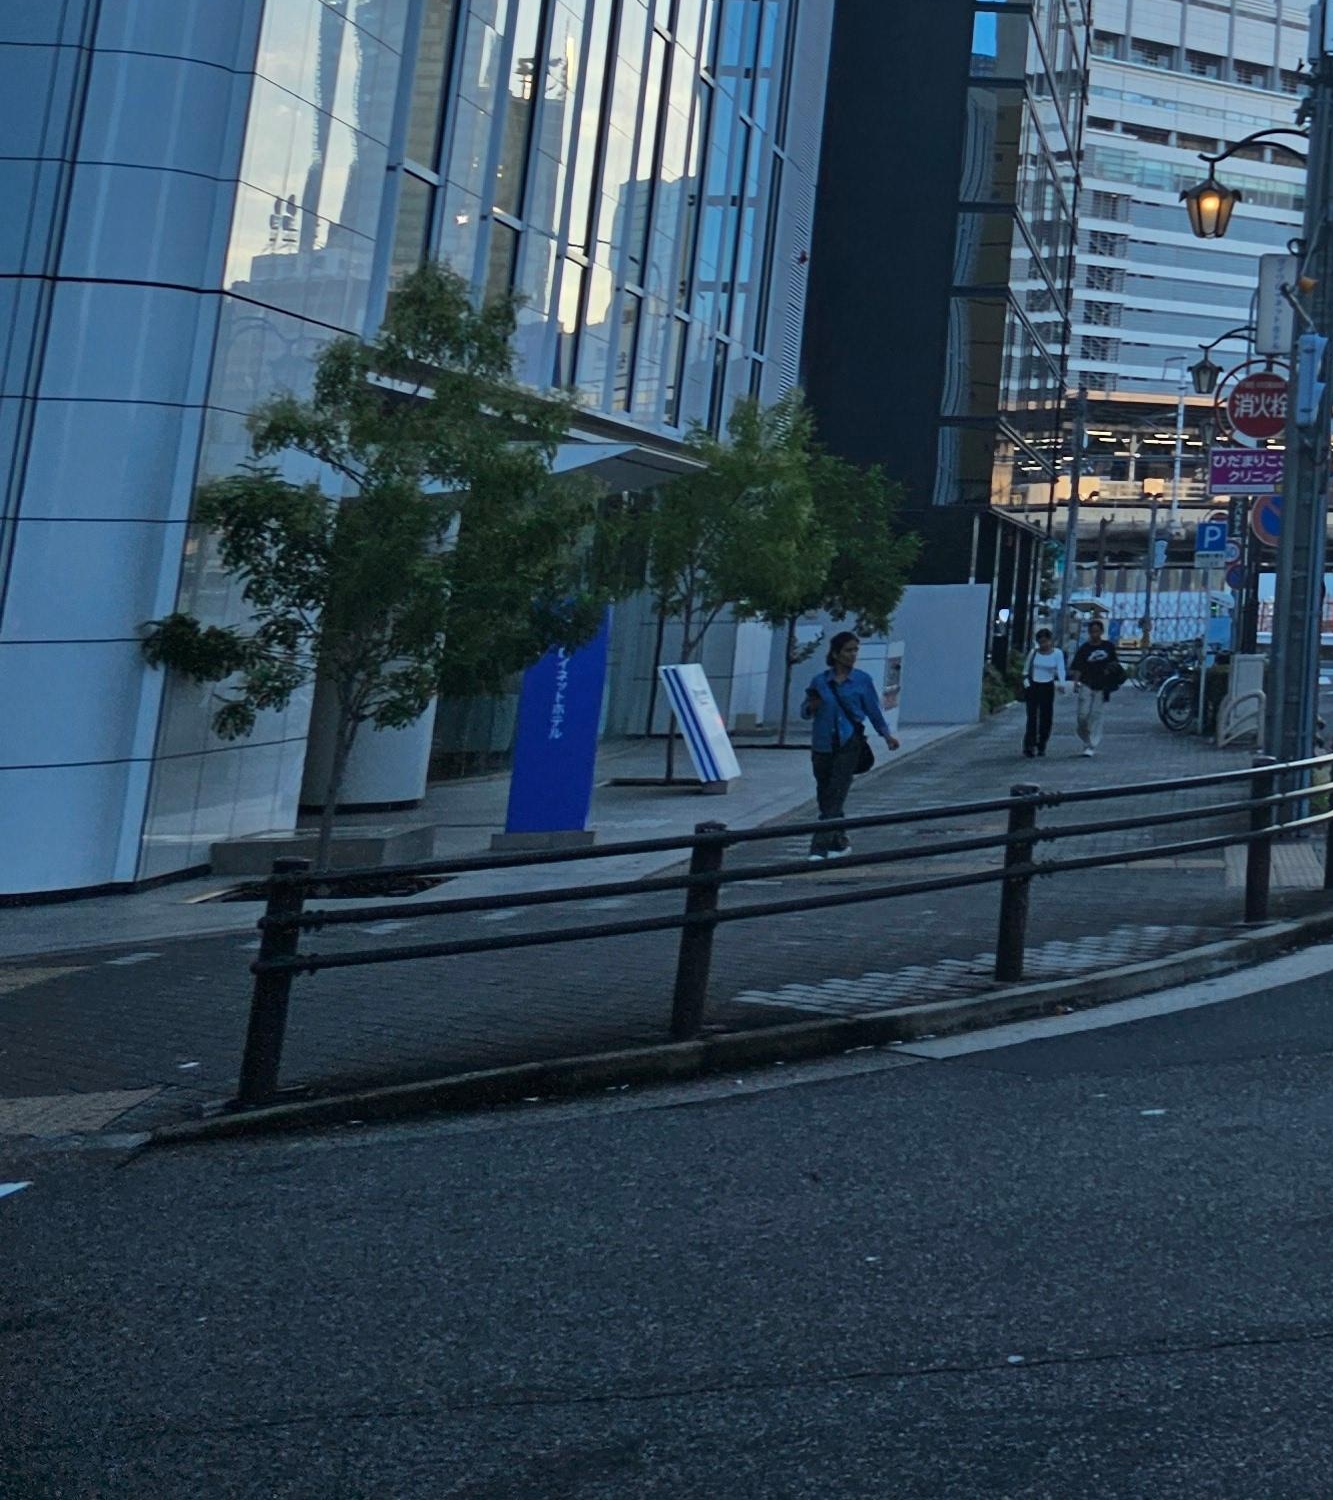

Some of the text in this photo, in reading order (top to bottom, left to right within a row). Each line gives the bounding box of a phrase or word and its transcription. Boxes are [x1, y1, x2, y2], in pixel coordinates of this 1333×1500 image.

[1234, 392, 1287, 418] 消火栓
[1203, 526, 1221, 549] P
